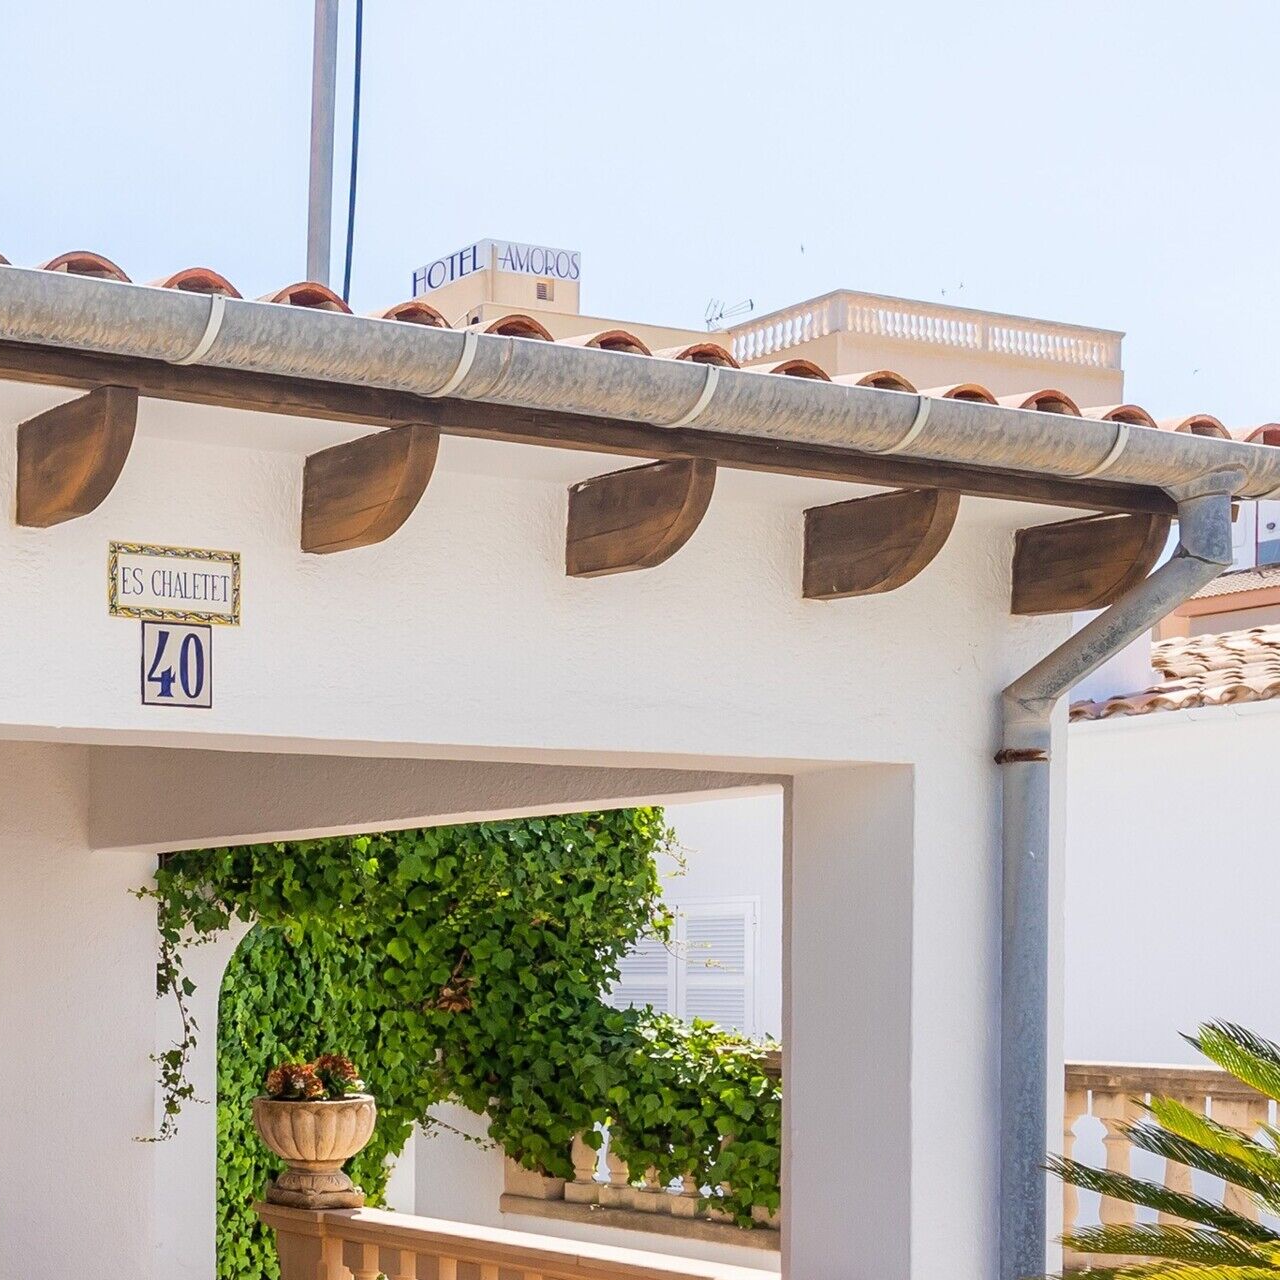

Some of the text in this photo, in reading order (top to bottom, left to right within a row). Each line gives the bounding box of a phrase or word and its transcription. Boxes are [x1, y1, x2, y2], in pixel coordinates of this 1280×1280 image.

[412, 244, 580, 298] HOTEL AMOROS
[121, 566, 230, 602] ES CHALETET
[147, 630, 205, 699] 40
